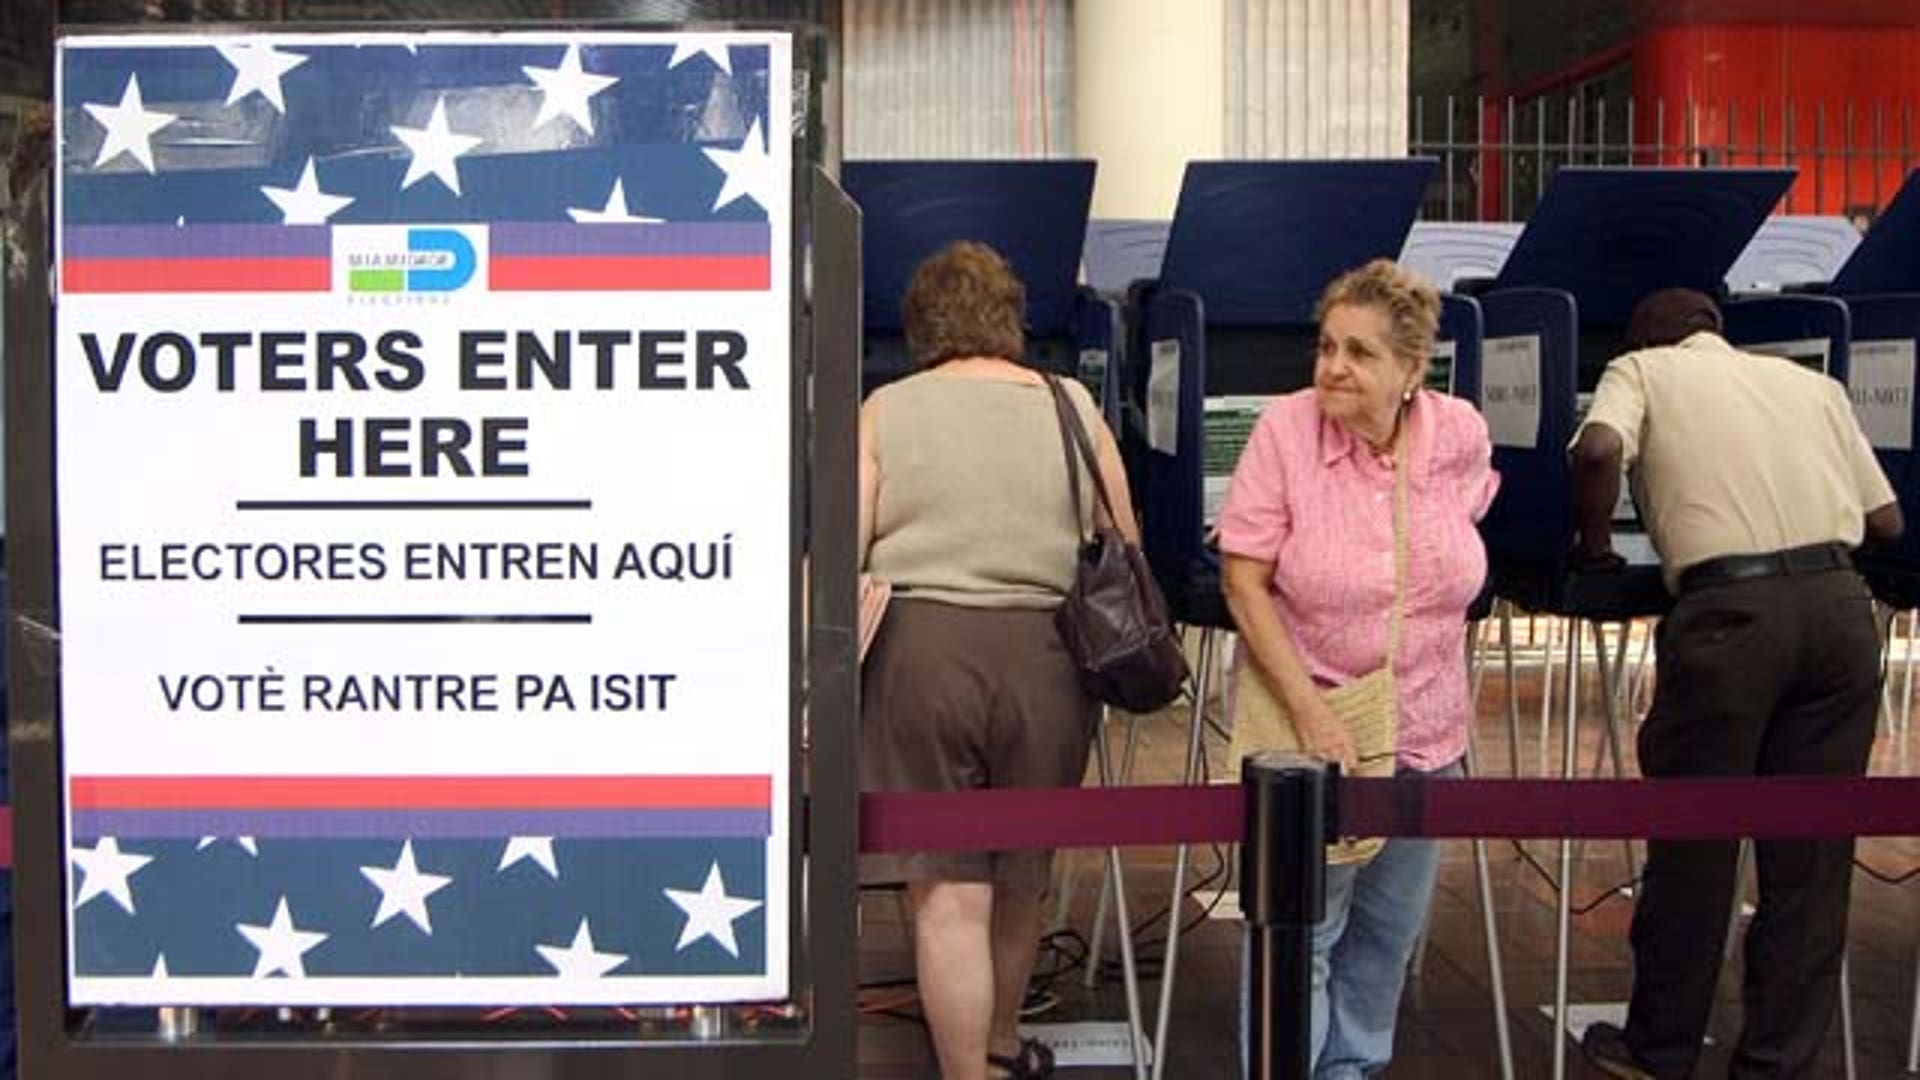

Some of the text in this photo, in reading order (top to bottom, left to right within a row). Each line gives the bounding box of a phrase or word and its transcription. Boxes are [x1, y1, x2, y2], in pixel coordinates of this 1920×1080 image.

[80, 331, 750, 392] VOTERS ENTER
[299, 417, 529, 477] HERE
[101, 533, 732, 580] ELECTORES ENTREN AQUÍ
[159, 666, 676, 711] VOTÈ RANTRE PA ISIT
